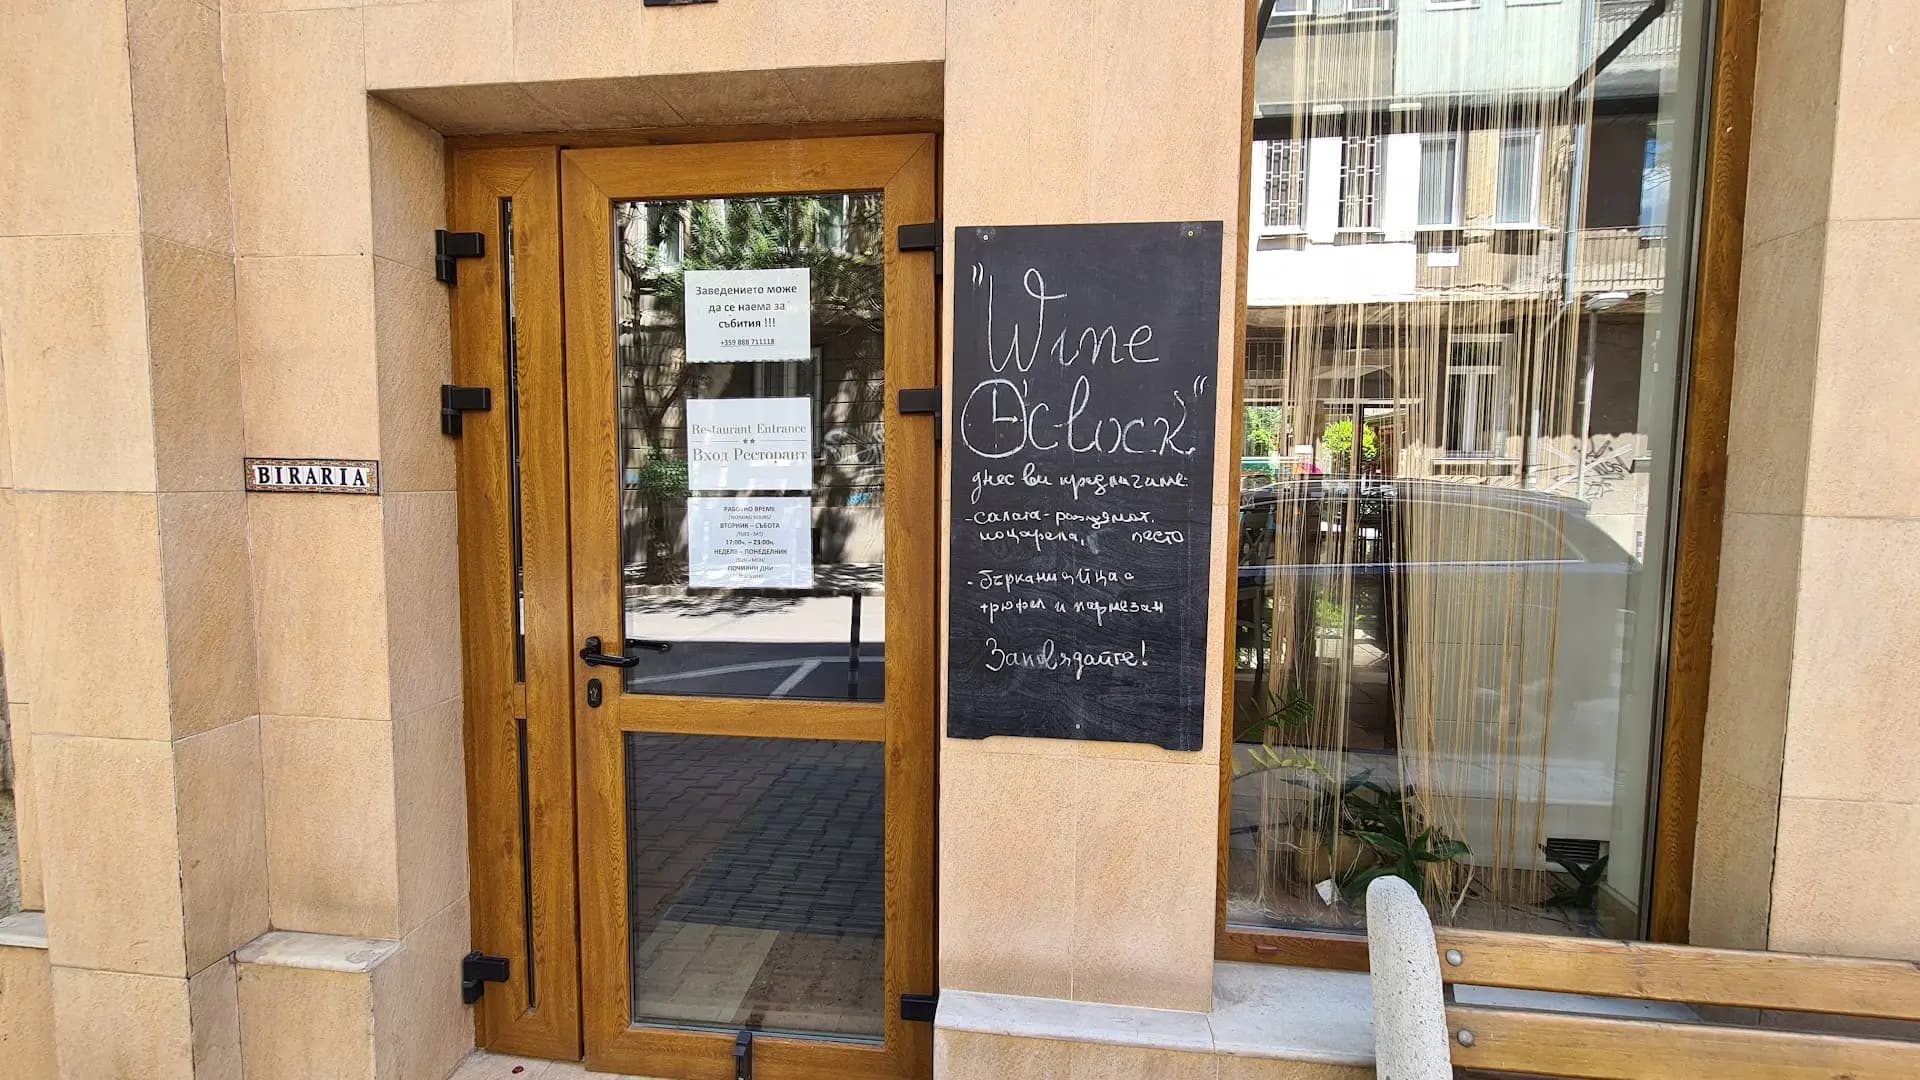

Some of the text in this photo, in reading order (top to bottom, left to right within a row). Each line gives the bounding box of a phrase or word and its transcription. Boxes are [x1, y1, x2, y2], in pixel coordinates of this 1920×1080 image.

[695, 284, 797, 296] Заведението може
[708, 302, 785, 314] да се наема за
[718, 317, 776, 328] събития !!!
[720, 339, 736, 347] +359
[692, 423, 806, 434] Restaurant Entrance
[693, 448, 807, 464] Вход Ресторант
[257, 467, 365, 486] BIRARIA
[971, 469, 1015, 504] днес
[1021, 463, 1052, 486] ви
[1131, 530, 1185, 545] песто
[760, 565, 774, 573] ДНИ
[977, 570, 1058, 593] бъркани
[979, 598, 1165, 627] трюфел и пармезан
[984, 638, 1149, 680] Заповядайте!
